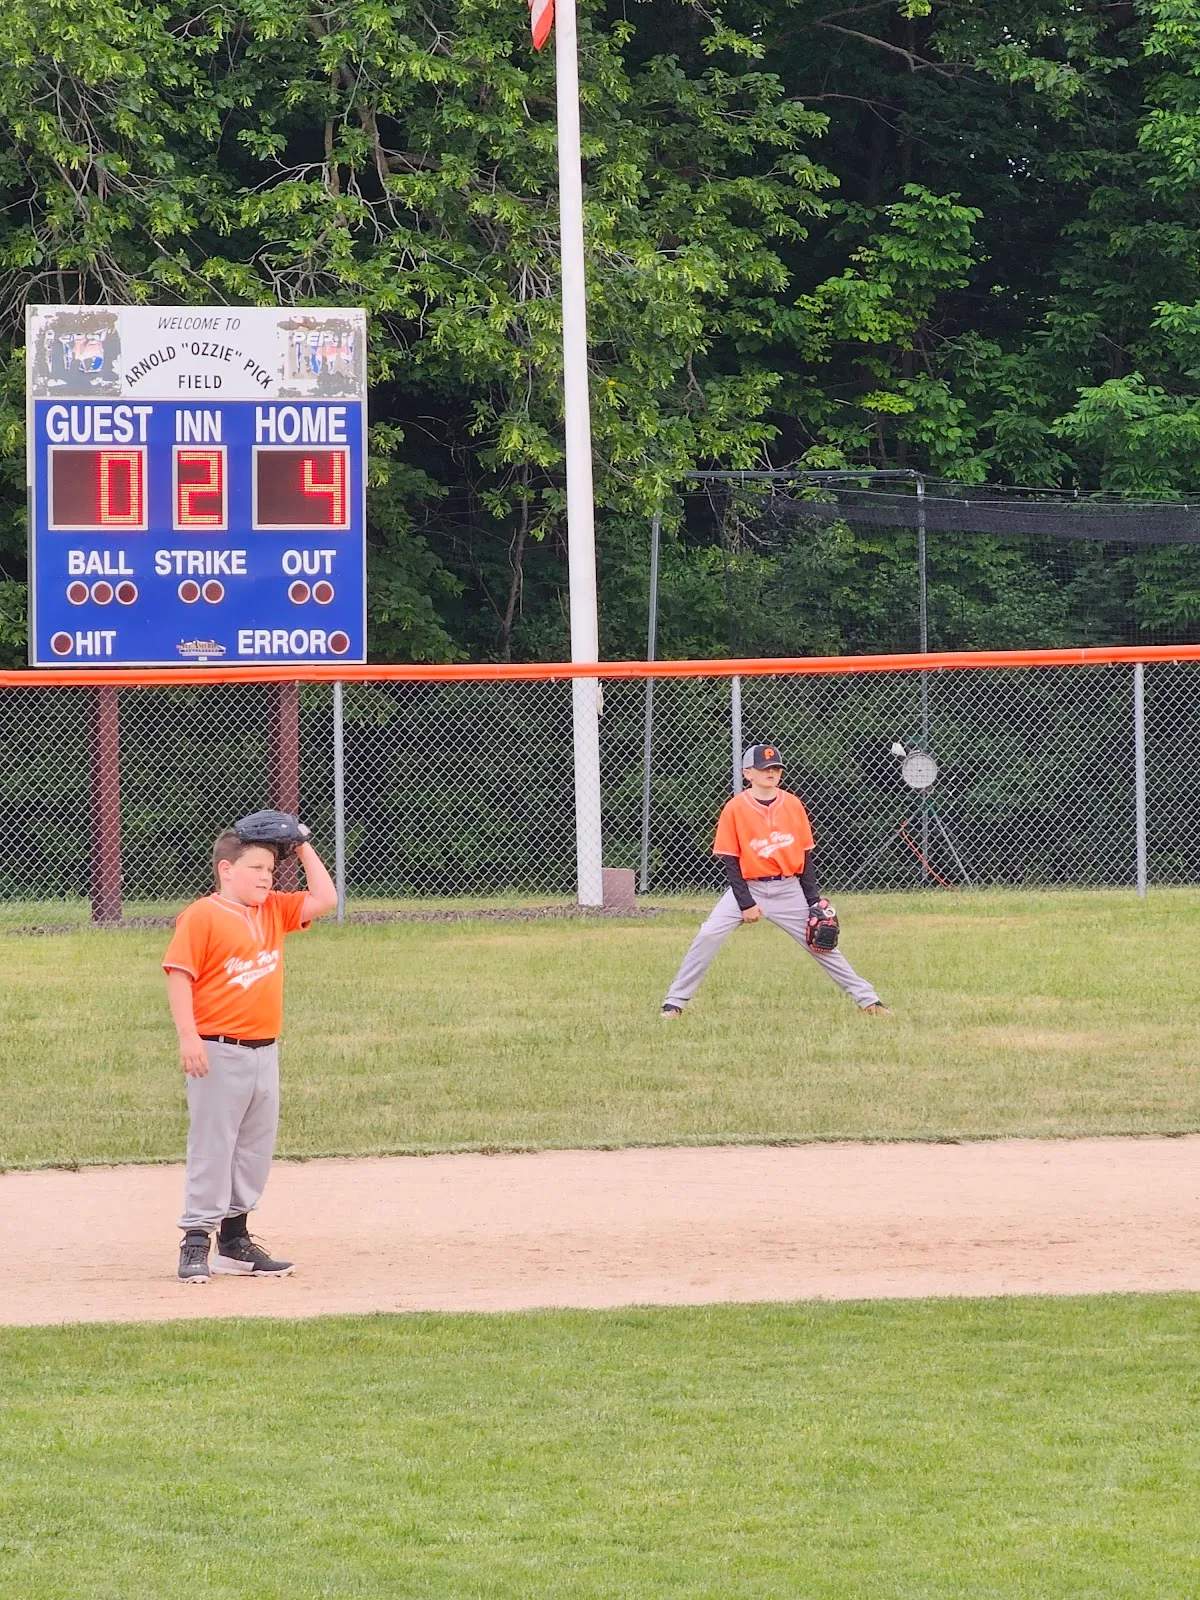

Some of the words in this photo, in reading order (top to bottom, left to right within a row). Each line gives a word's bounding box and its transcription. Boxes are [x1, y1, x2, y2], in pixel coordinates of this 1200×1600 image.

[158, 317, 221, 330] WELCOME
[225, 317, 241, 331] TO
[125, 346, 176, 387] ARNOLD
[181, 342, 242, 362] "OZZIE"
[243, 358, 273, 389] PICK
[178, 374, 222, 388] FIELD
[45, 405, 153, 442] GUEST
[175, 410, 222, 442] INN
[255, 406, 347, 442] HOME
[98, 450, 142, 525] 0
[178, 450, 221, 525] 2
[302, 450, 343, 525] 4
[68, 550, 134, 575] BALL
[154, 549, 247, 575] STRIKE
[281, 549, 337, 575] OUT
[75, 630, 117, 656] HIT
[237, 629, 327, 655] ERROR
